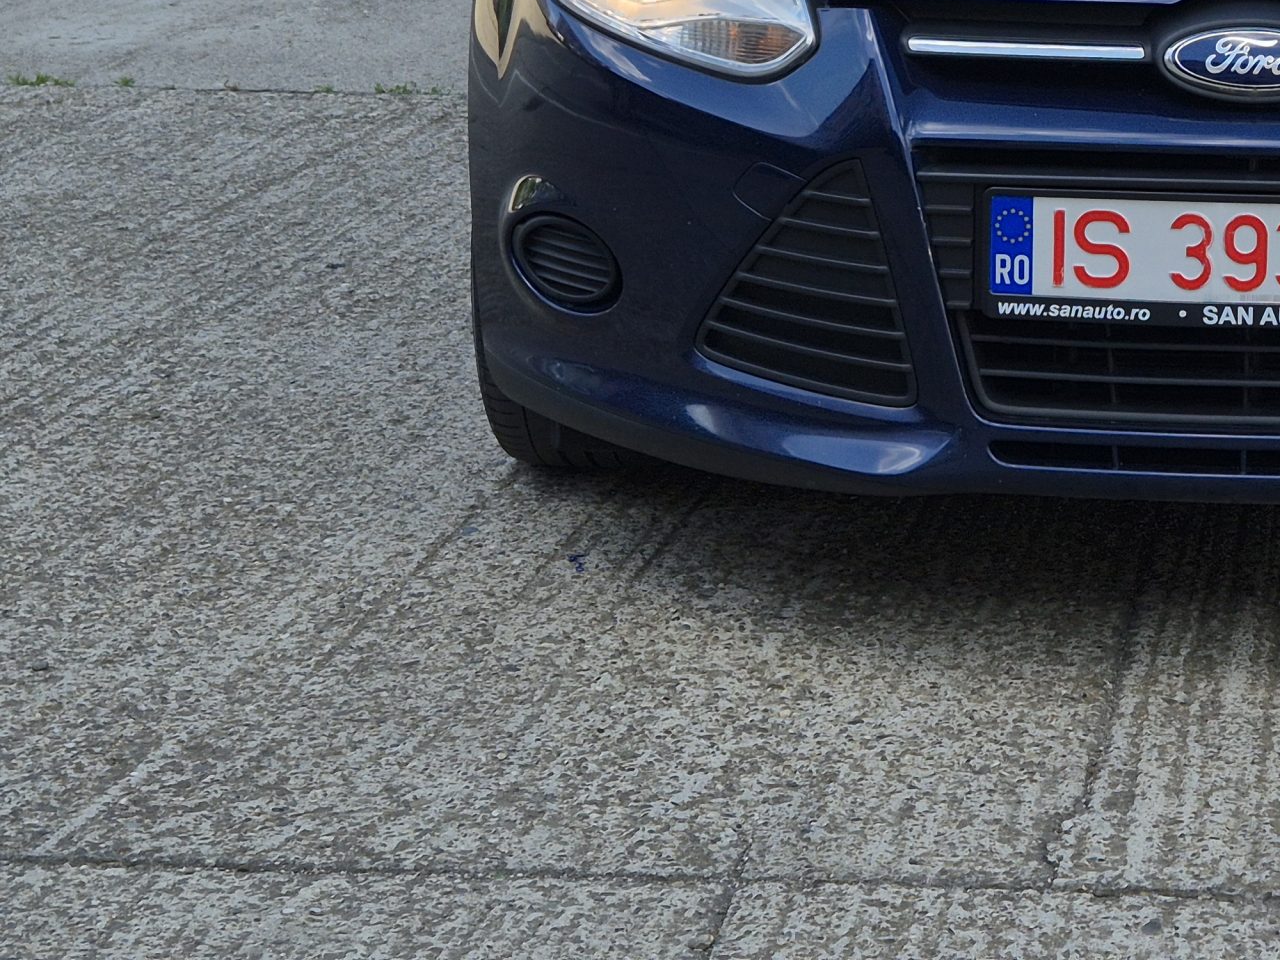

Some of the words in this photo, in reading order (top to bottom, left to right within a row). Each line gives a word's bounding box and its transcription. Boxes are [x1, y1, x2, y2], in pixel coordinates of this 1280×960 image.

[1052, 208, 1131, 289] IS
[995, 253, 1030, 285] RO
[998, 300, 1151, 321] www.sanauto.ro
[1202, 305, 1254, 326] SAN
